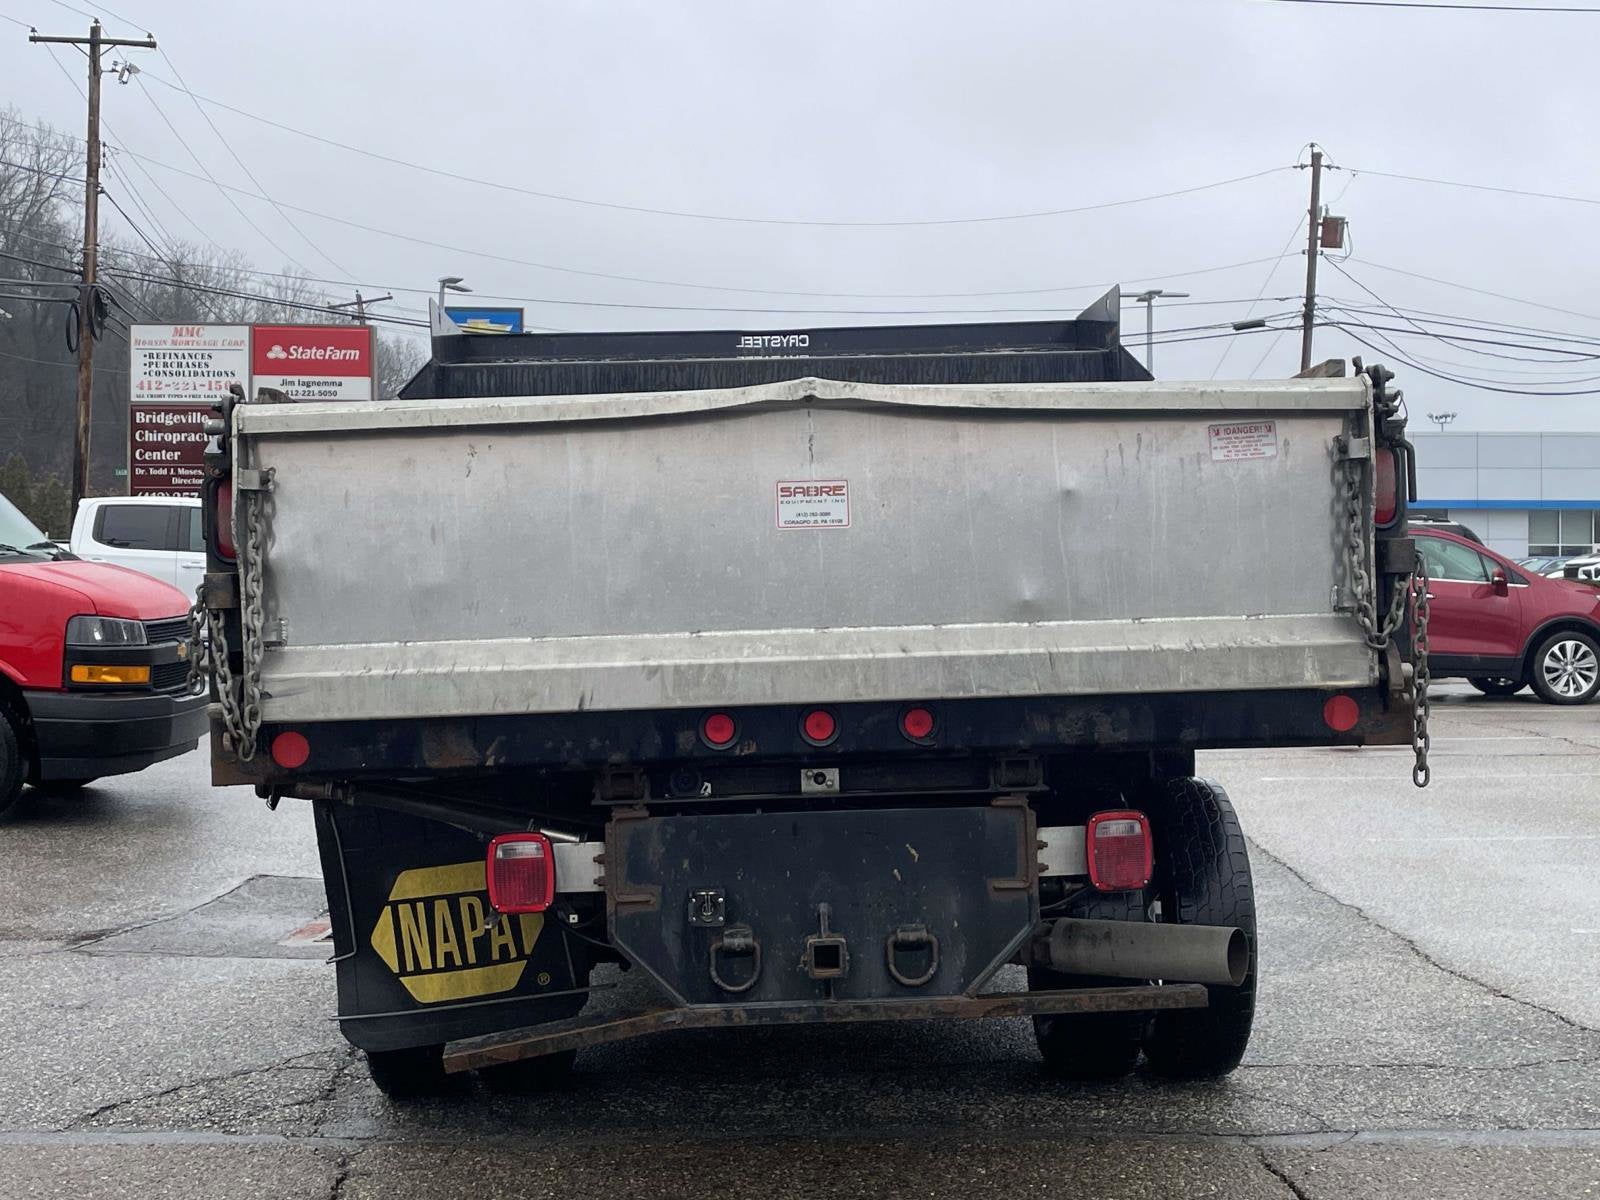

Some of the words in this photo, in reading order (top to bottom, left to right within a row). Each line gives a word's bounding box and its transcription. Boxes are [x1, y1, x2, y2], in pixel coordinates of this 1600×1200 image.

[172, 327, 205, 337] MMC
[280, 379, 296, 387] Jim
[297, 379, 343, 388] Iagnemma
[135, 412, 209, 426] Bridgeville
[135, 430, 211, 444] Chiropract
[135, 449, 181, 460] Center
[135, 467, 147, 475] Dr.
[149, 467, 168, 475] Todd
[780, 485, 845, 497] SABRE
[397, 895, 518, 973] NAPA
